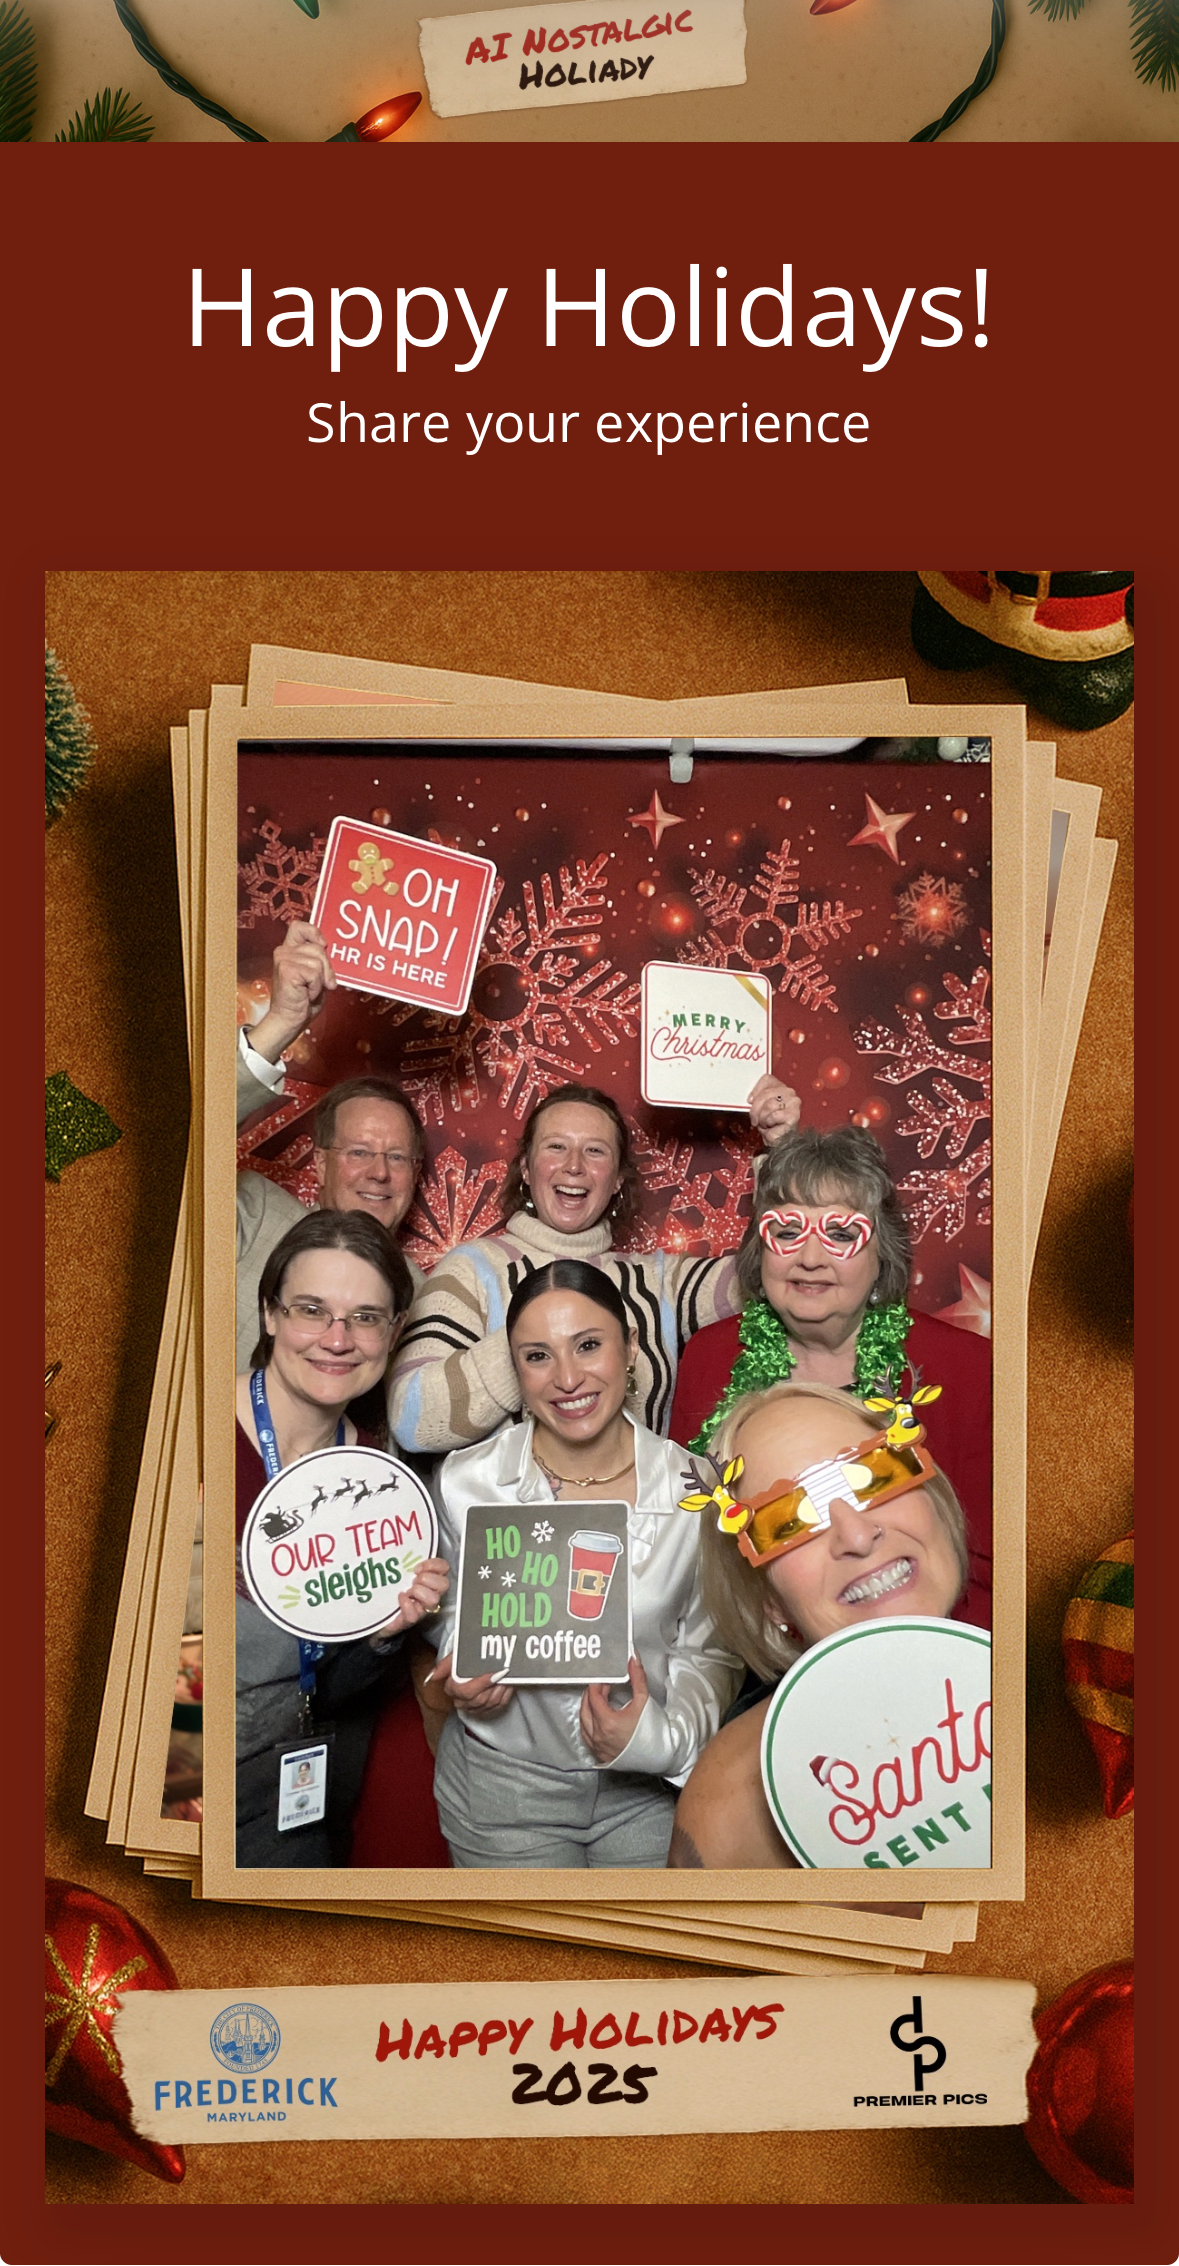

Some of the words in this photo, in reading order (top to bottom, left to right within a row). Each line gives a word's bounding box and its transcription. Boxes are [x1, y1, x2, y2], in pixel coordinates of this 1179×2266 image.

[403, 868, 459, 917] OH
[336, 900, 458, 965] SNAP!
[331, 943, 361, 965] HR
[366, 953, 386, 971] IS
[392, 960, 447, 988] HERE
[673, 1013, 746, 1033] MERRY
[651, 1025, 765, 1061] Christmas
[271, 1533, 335, 1577] OUR
[345, 1511, 422, 1557] TEAM
[486, 1525, 521, 1559] HO
[304, 1557, 402, 1607] sleighs
[521, 1551, 559, 1587] HO
[481, 1592, 552, 1628] HOLD
[481, 1633, 517, 1667] my
[525, 1630, 601, 1662] coffee
